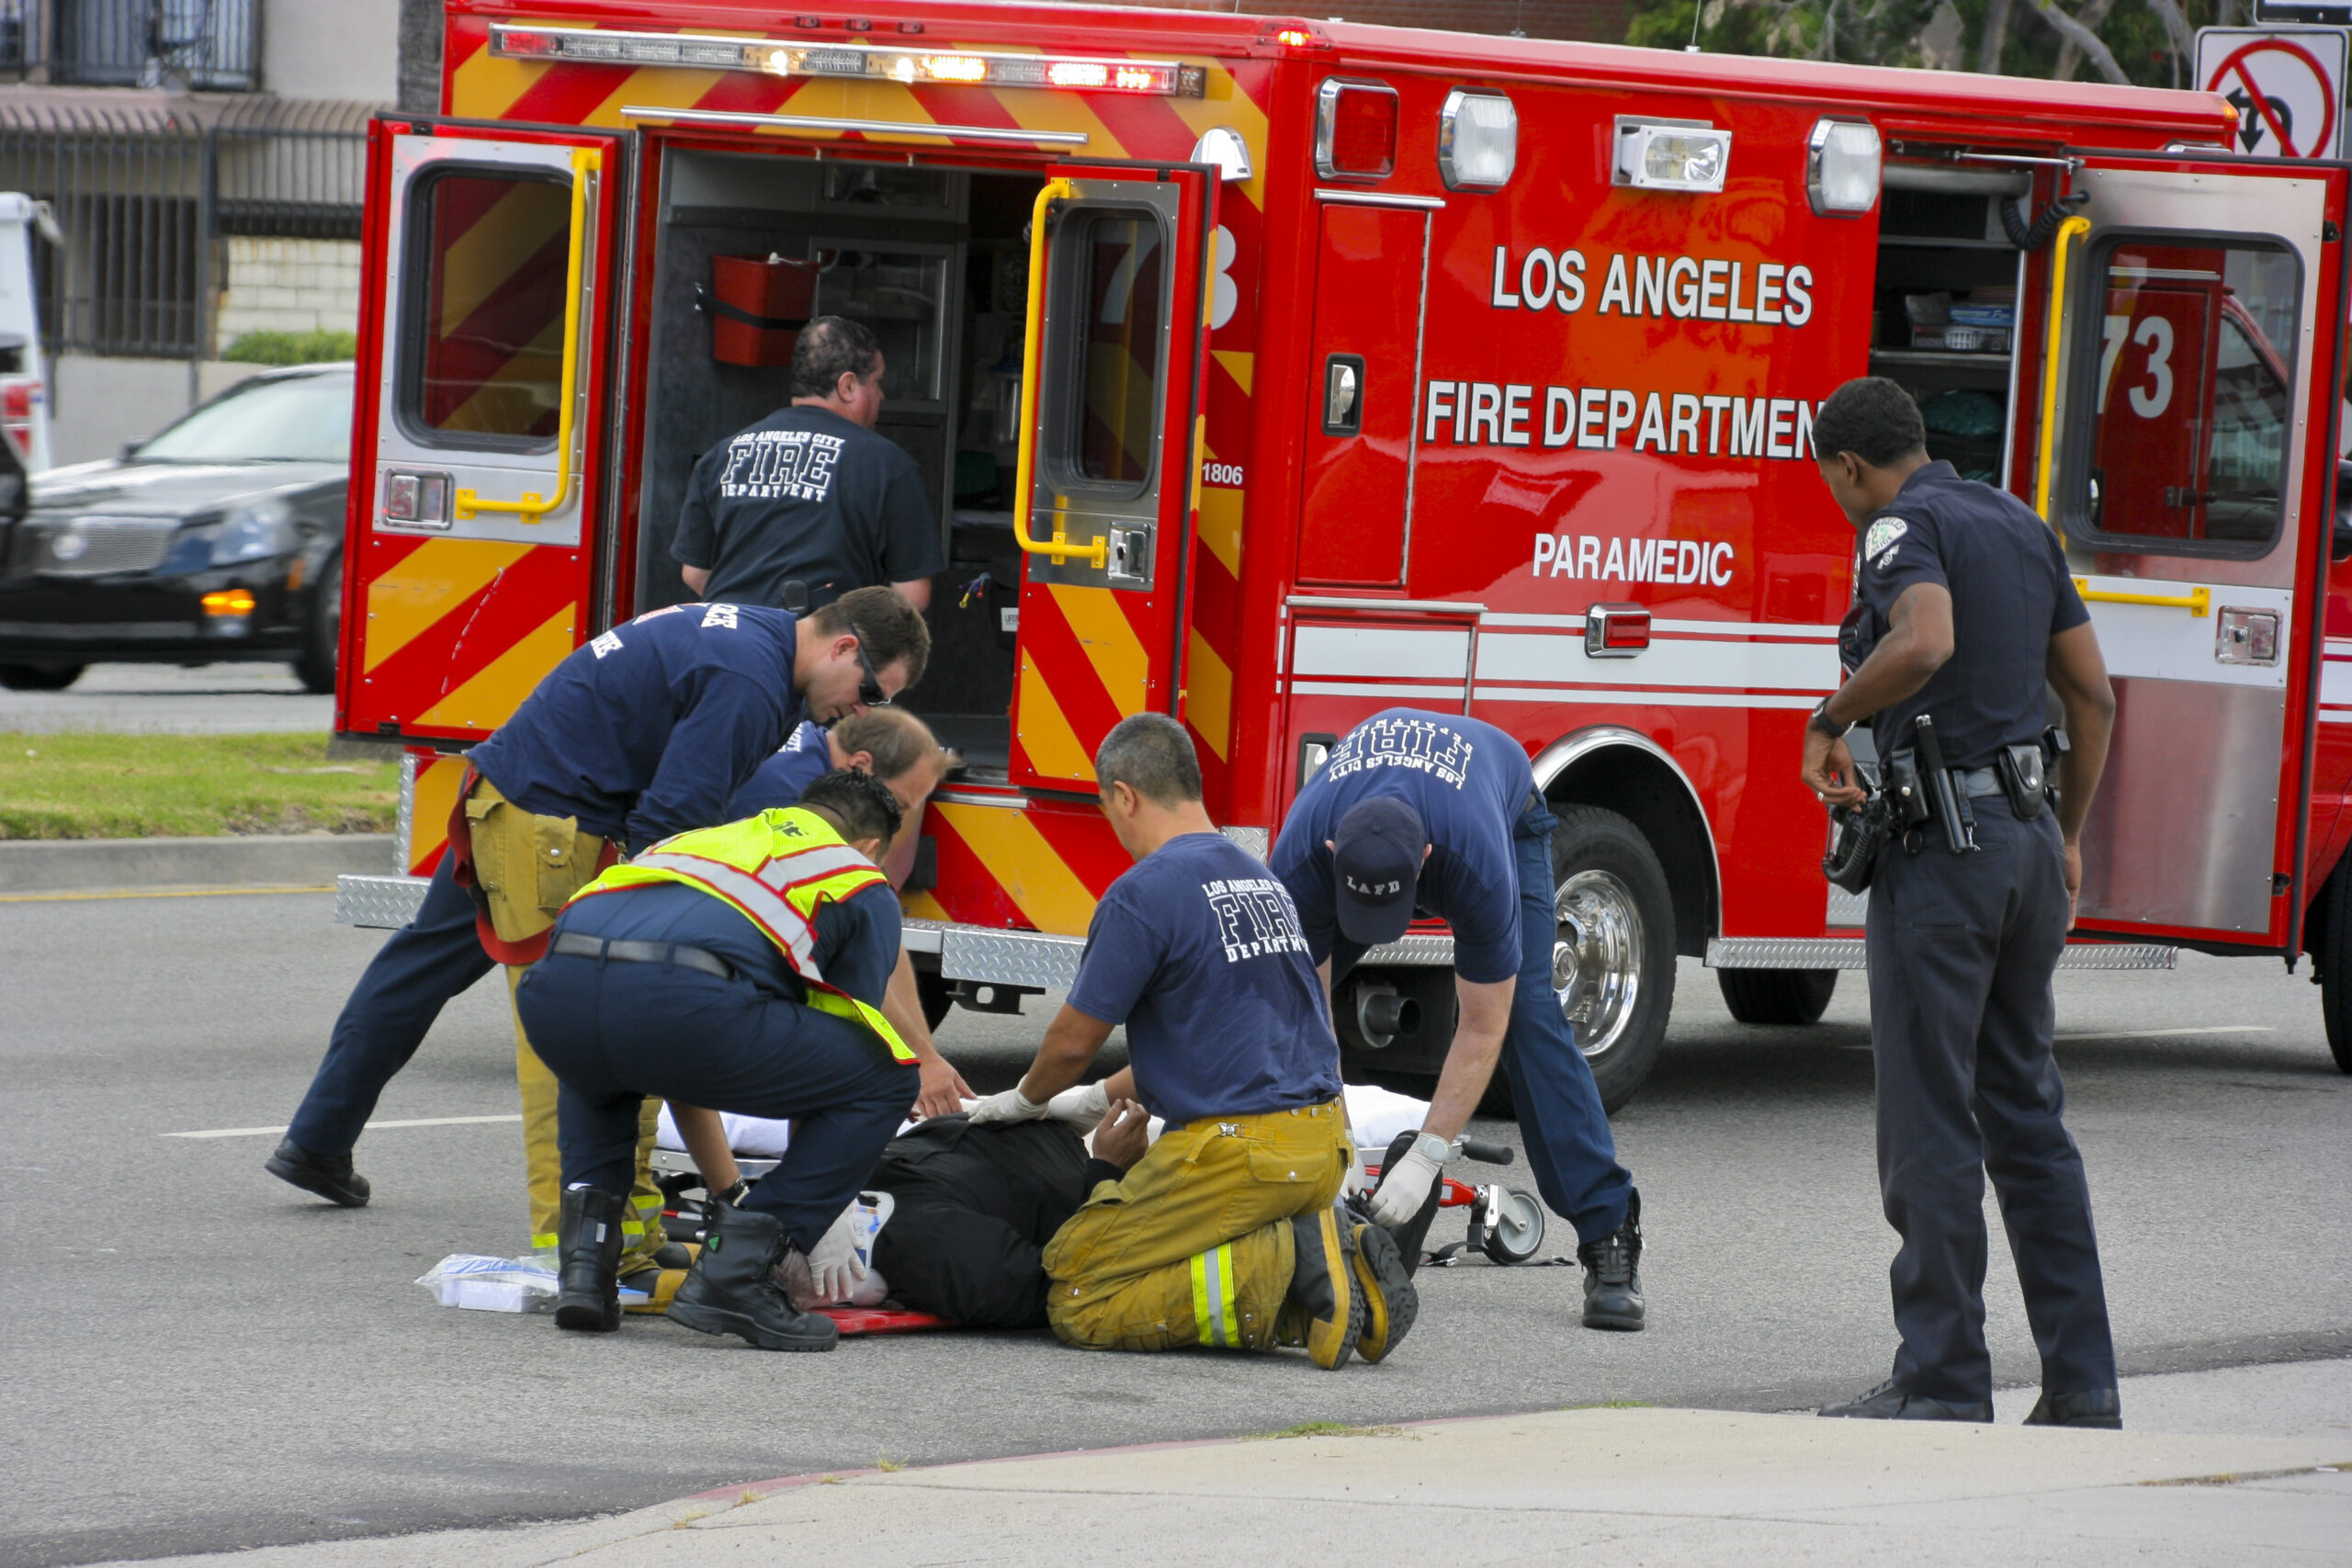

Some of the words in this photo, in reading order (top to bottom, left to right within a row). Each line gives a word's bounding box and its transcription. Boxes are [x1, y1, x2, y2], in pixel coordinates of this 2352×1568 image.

[1491, 244, 1588, 314] LOS
[1597, 253, 1815, 329] ANGELES
[2097, 315, 2175, 419] 73
[1424, 379, 1533, 447] FIRE
[1544, 386, 1826, 460] DEPARTMEN
[732, 432, 756, 443] LOS
[754, 430, 812, 443] ANGELES
[811, 433, 846, 448] CITY
[719, 441, 842, 491] FIRE
[1202, 462, 1244, 486] 1806
[1532, 532, 1735, 587] PARAMEDIC
[1329, 724, 1471, 782] FIRE
[1329, 759, 1363, 783] CITY
[1365, 753, 1435, 773] ANGELES
[1435, 766, 1464, 791] LOS
[1202, 880, 1228, 898] LOS
[1227, 879, 1274, 893] ANGELES
